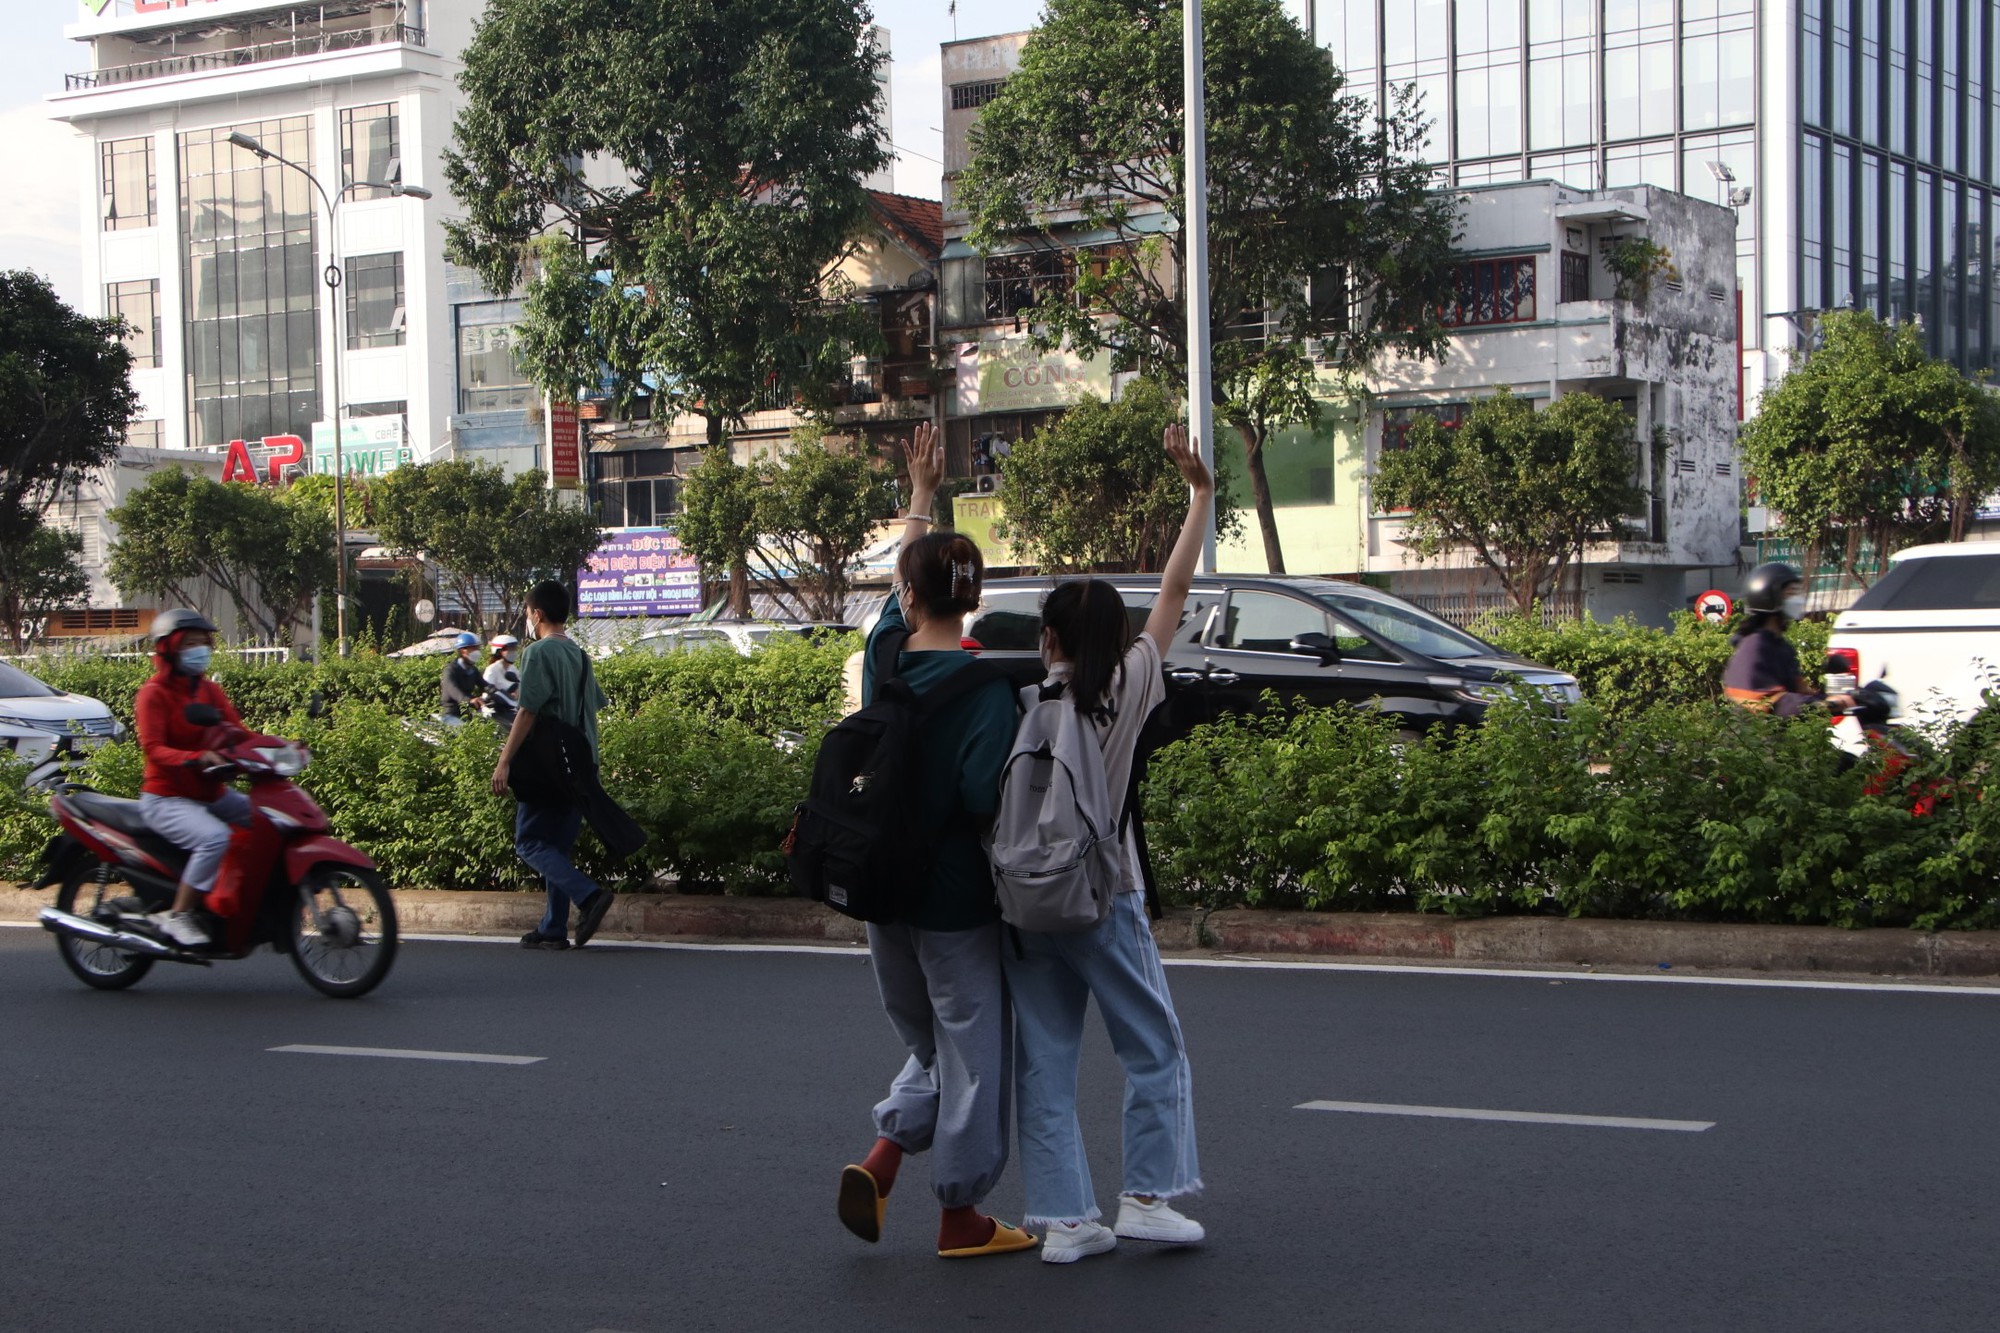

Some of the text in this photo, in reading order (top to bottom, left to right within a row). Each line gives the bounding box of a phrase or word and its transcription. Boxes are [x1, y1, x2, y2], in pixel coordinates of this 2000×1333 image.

[1003, 361, 1085, 388] CÔNG
[375, 428, 398, 441] CBRE
[221, 434, 305, 484] AP
[318, 447, 413, 476] TOWER
[580, 590, 594, 602] CÁC
